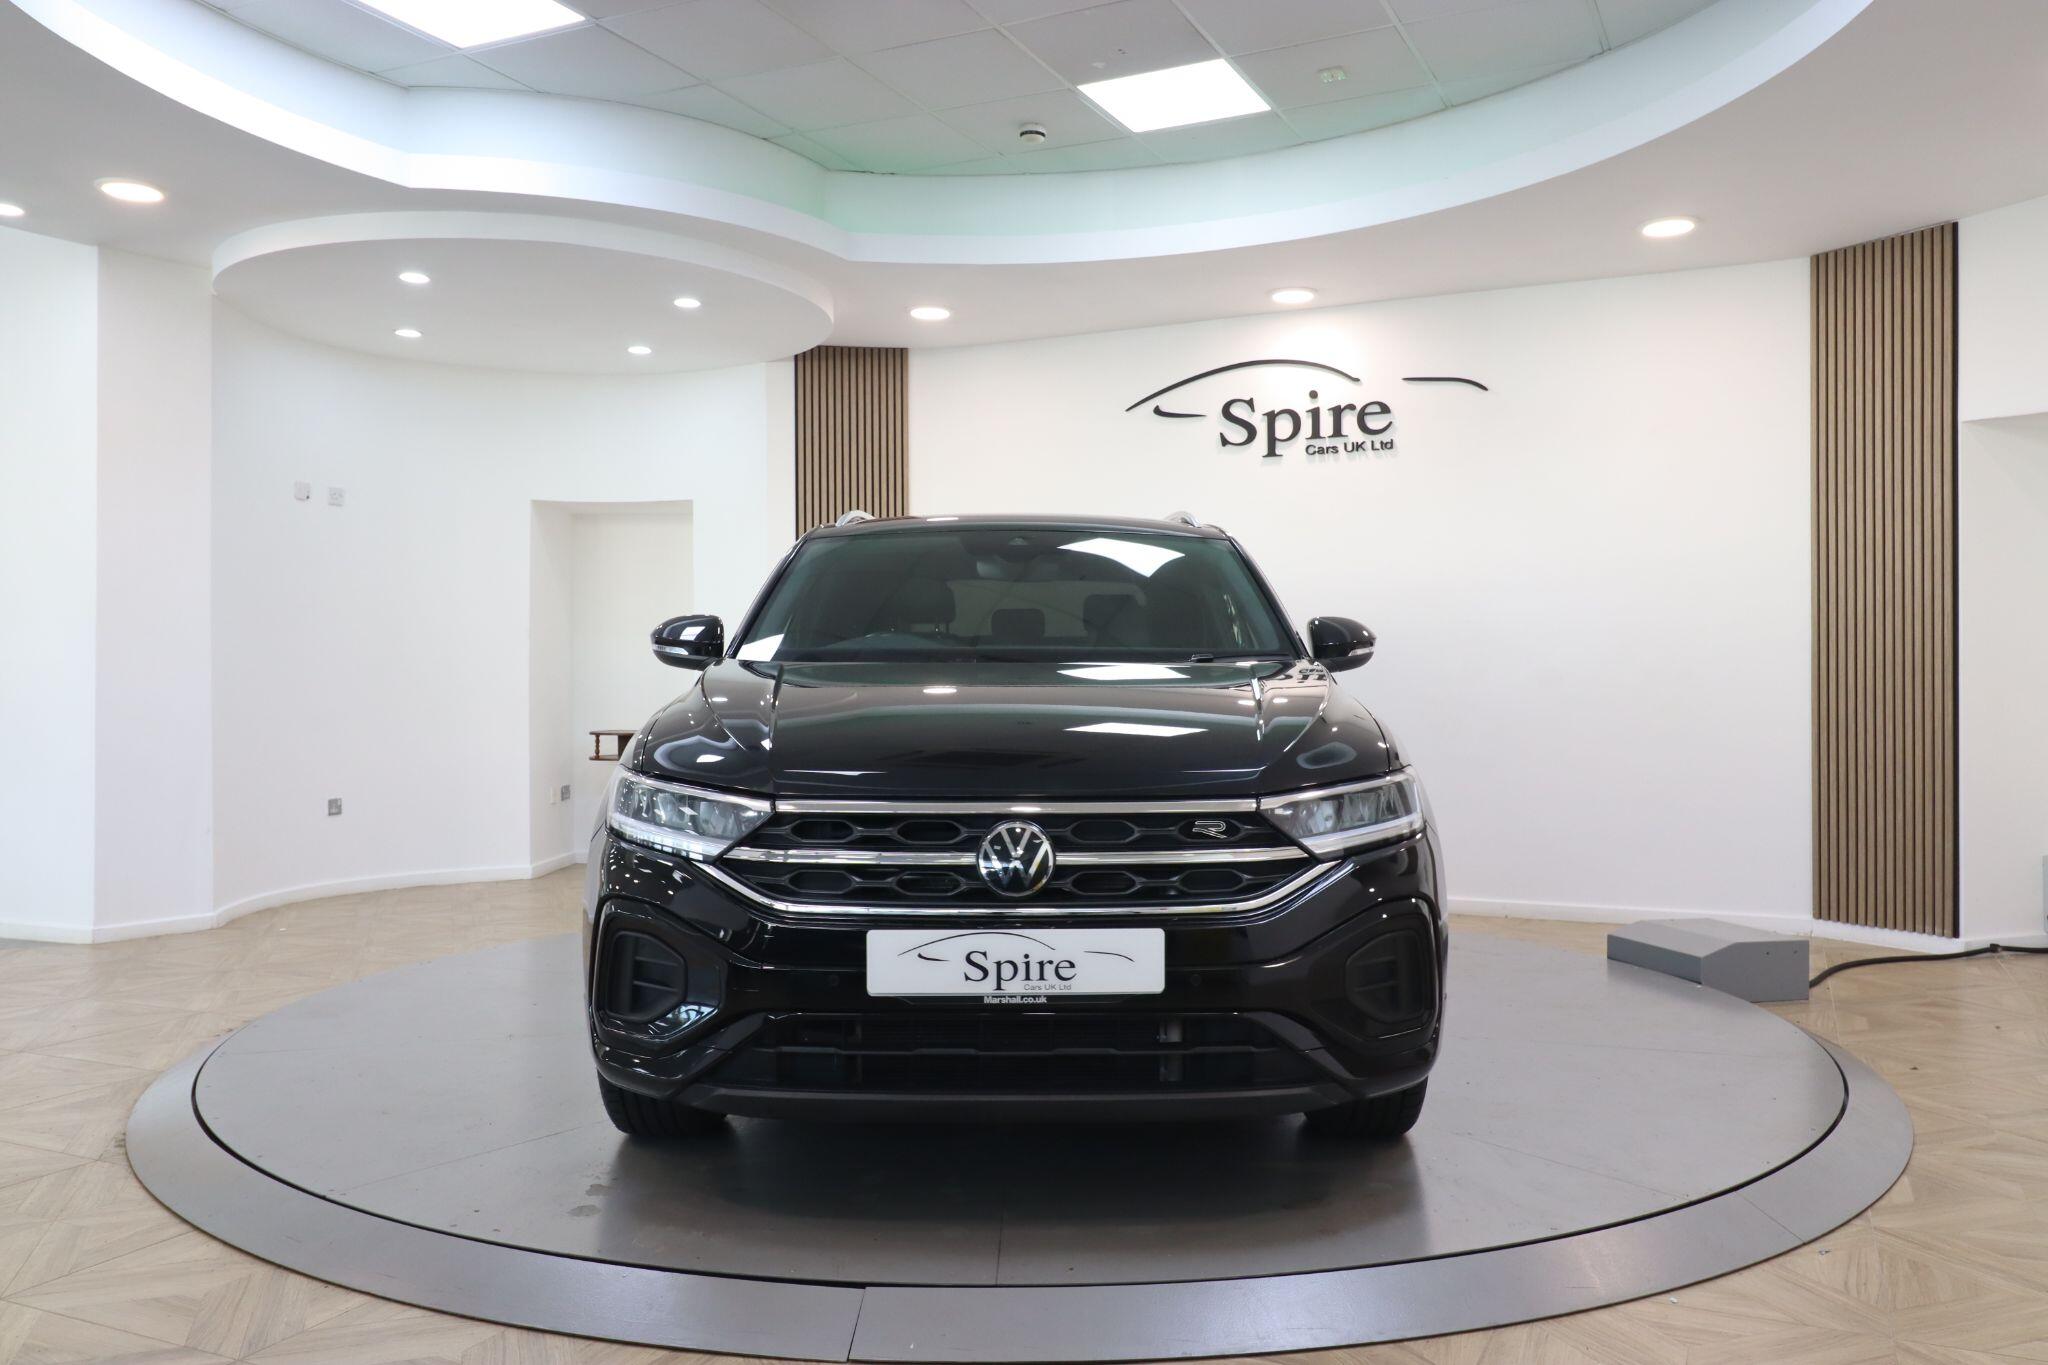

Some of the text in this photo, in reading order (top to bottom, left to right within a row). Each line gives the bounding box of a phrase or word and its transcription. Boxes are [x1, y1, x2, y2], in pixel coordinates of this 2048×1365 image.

[1219, 390, 1393, 457] Spire
[1305, 439, 1393, 456] Cars UK Ltd
[963, 950, 1077, 991] Spire
[1024, 983, 1042, 991] Cars
[983, 995, 1047, 1004] Marshall.co.uk
